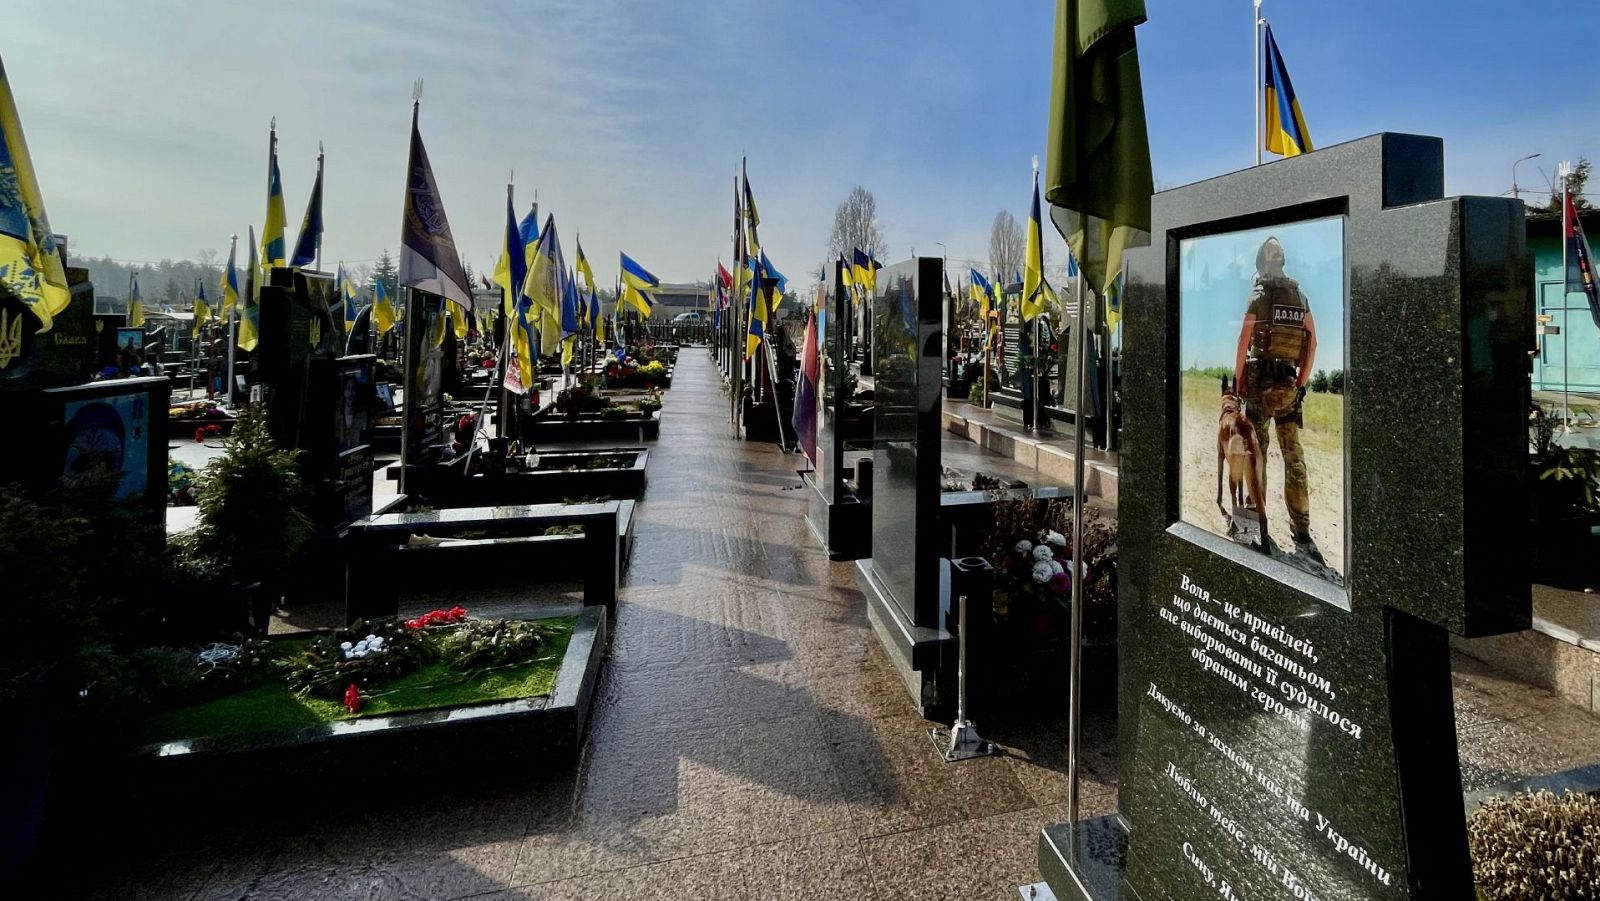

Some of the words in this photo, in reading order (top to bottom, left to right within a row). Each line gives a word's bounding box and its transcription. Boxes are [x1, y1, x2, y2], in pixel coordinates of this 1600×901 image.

[1173, 594, 1191, 613] що
[1193, 603, 1247, 646] дається
[1250, 636, 1335, 699] багатьом,
[1180, 574, 1210, 602] Воля
[1224, 602, 1241, 619] це
[1243, 611, 1318, 663] привілей,
[1159, 606, 1179, 626] але
[1180, 619, 1262, 678] виборювати
[1265, 666, 1278, 687] її
[1280, 680, 1362, 739] судилося
[1191, 647, 1248, 692] обраним
[1250, 686, 1308, 730] героям
[1146, 682, 1192, 725] Дякуємо
[1193, 721, 1205, 737] за
[1208, 731, 1254, 775] захист
[1257, 773, 1283, 798] нас
[1286, 796, 1310, 821] та
[1315, 811, 1391, 886] України
[1164, 761, 1207, 808] Люблю
[1210, 806, 1247, 849] тебе,
[1250, 843, 1277, 874] мій
[1183, 841, 1216, 888] Сину,
